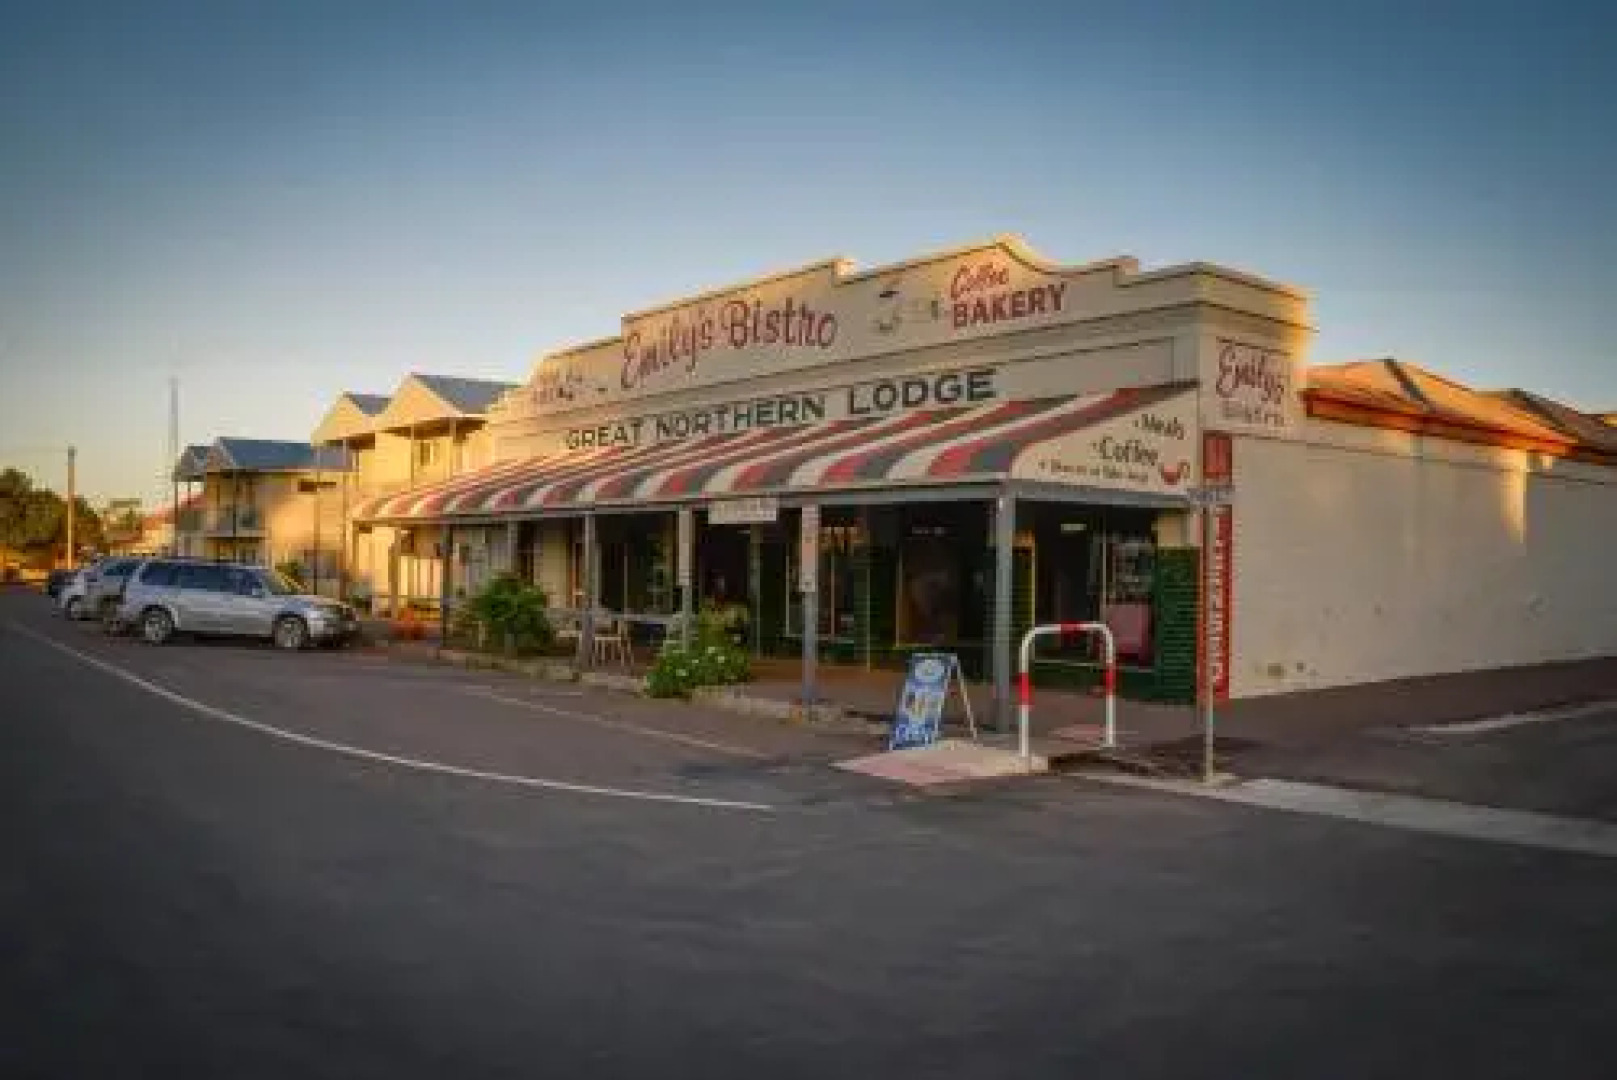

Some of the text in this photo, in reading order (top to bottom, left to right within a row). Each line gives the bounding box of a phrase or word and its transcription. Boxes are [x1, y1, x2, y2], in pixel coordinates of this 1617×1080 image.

[620, 305, 714, 391] Emily's
[717, 296, 839, 350] Bistro
[953, 281, 1066, 328] BAKERY
[564, 368, 997, 451] GREAT NORTHERN LODGE
